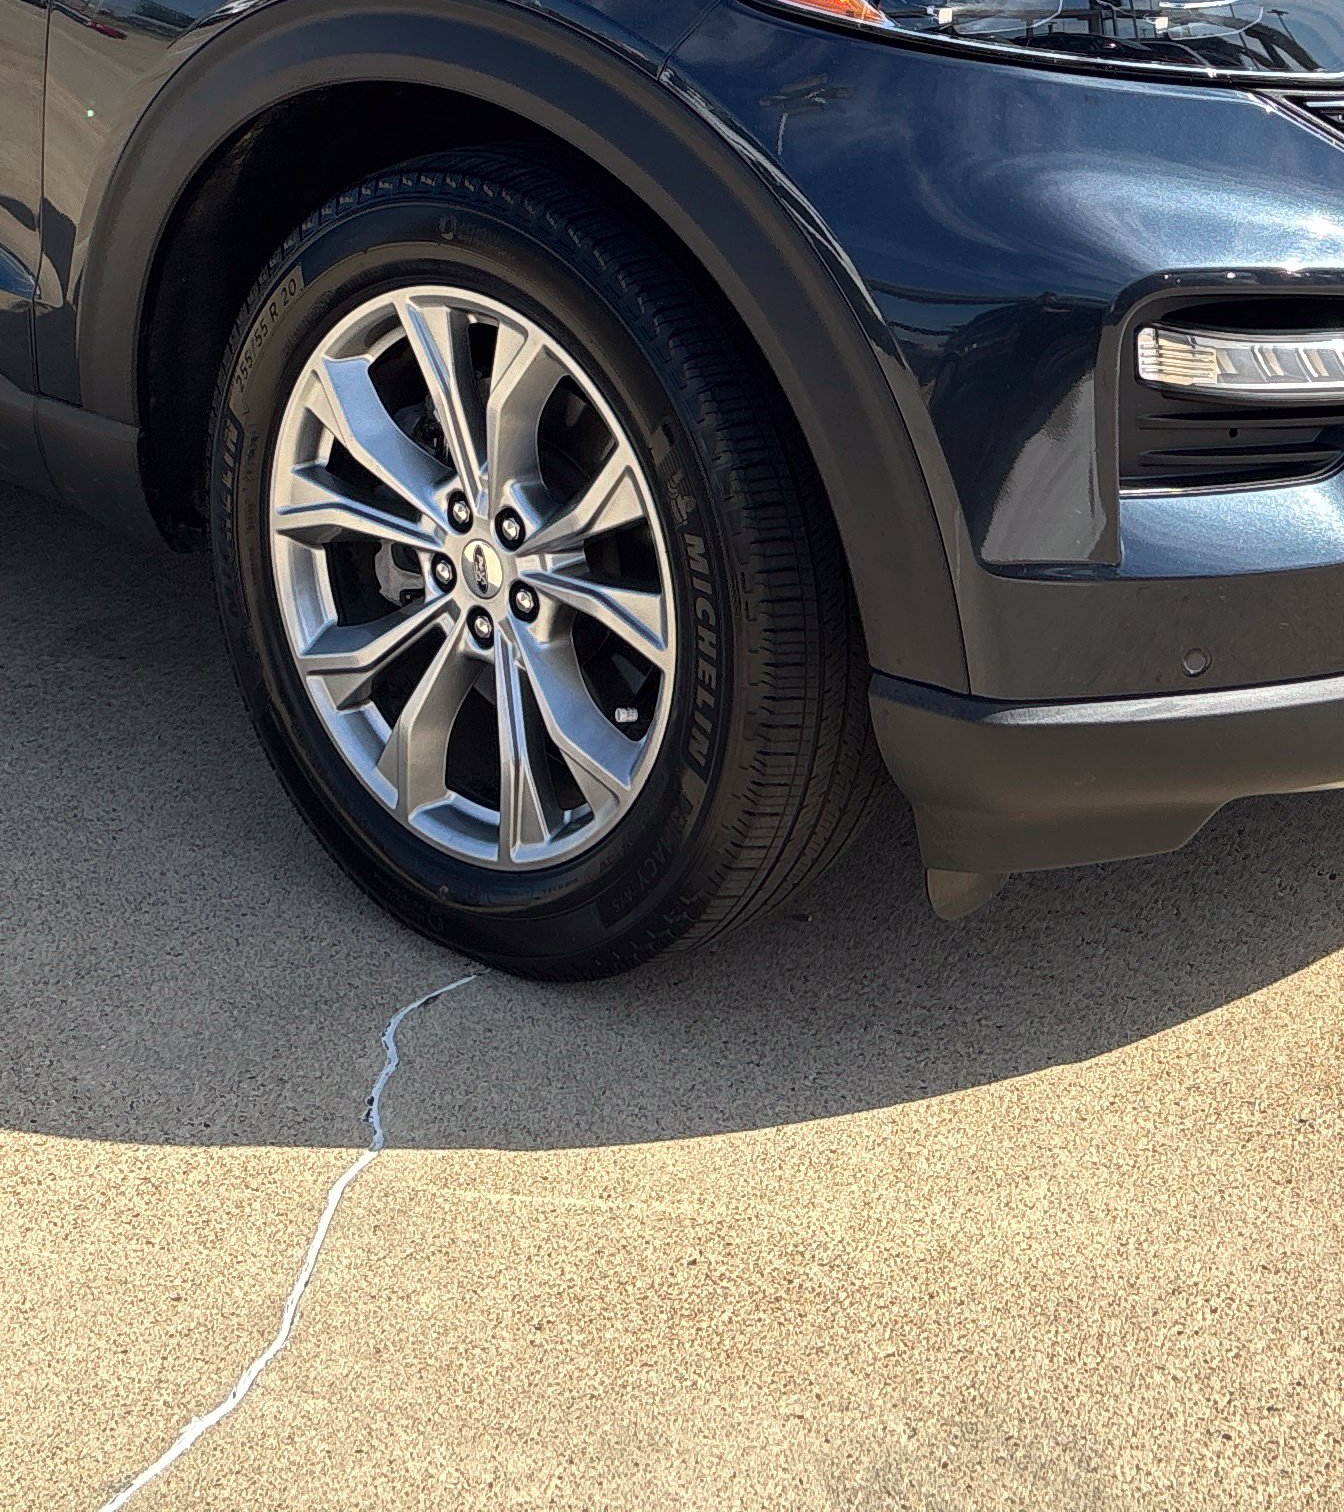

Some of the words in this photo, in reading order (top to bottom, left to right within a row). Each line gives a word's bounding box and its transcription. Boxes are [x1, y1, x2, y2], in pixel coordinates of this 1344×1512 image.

[268, 301, 279, 324] R
[280, 277, 297, 307] 20
[682, 532, 718, 768] MICHELIN
